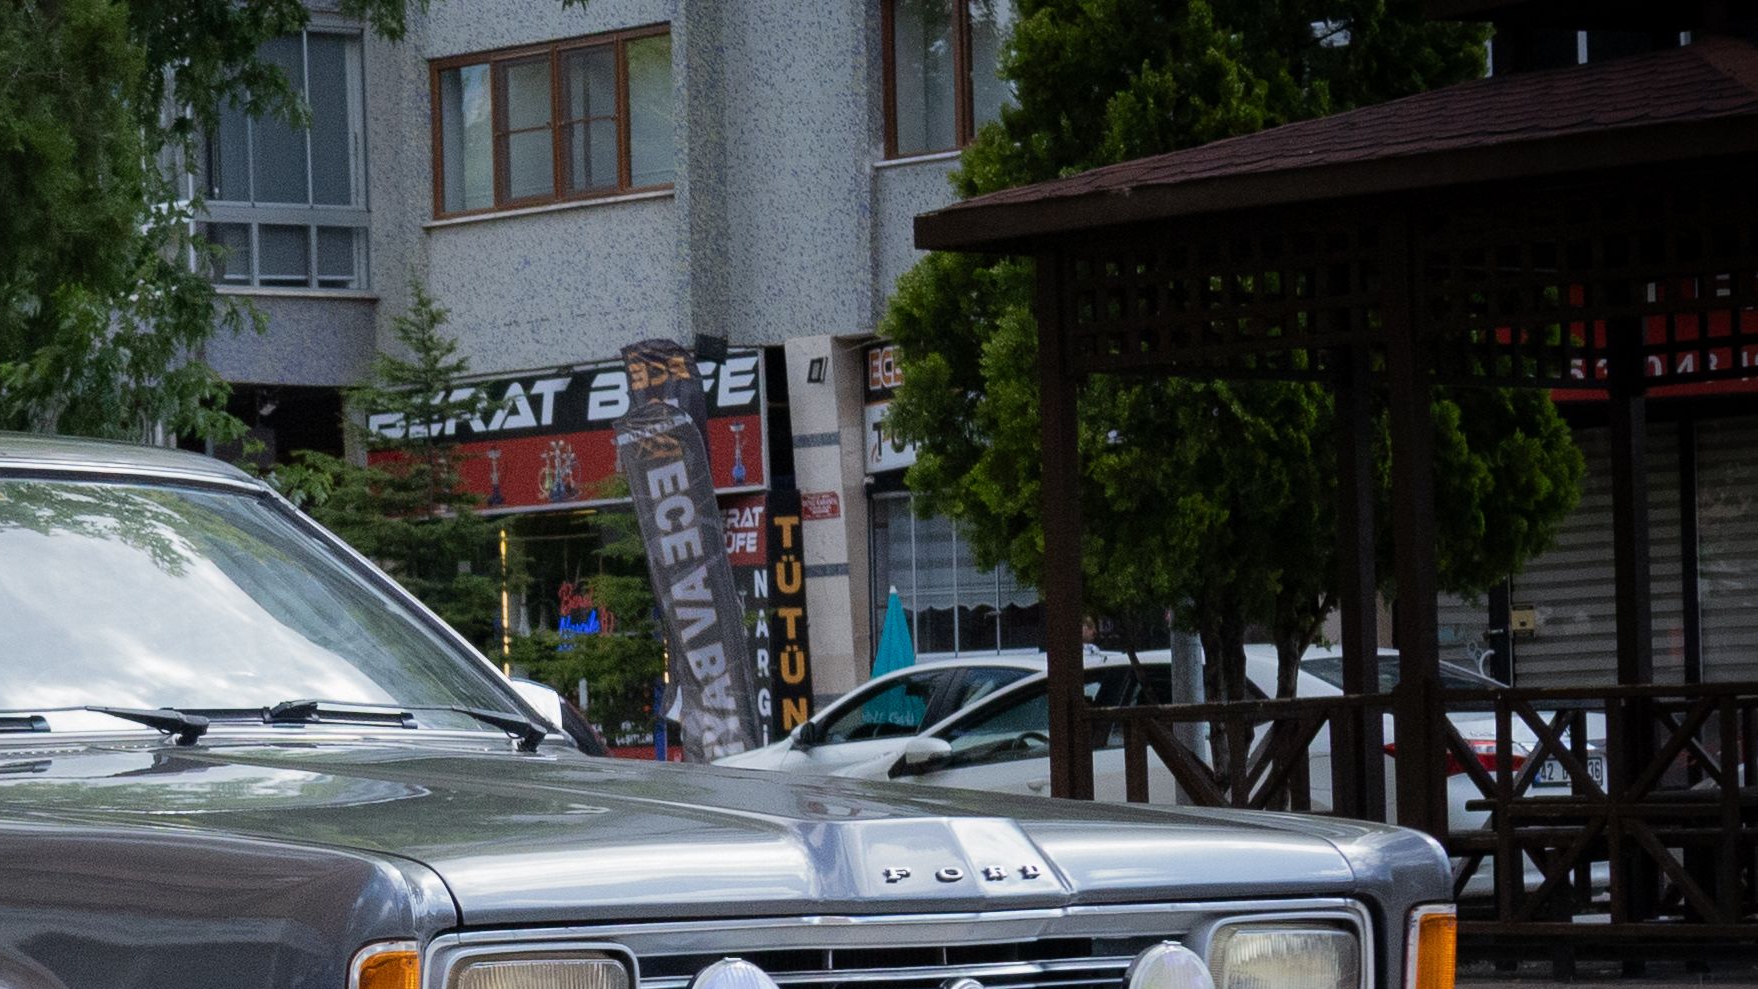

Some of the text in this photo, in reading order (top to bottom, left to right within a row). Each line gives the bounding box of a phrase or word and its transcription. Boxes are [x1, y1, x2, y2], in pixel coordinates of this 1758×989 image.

[588, 357, 759, 421] BE
[723, 506, 764, 529] RAT
[724, 531, 758, 554] ÜFE
[773, 516, 809, 731] TÜTÜN
[883, 864, 1041, 883] FORD
